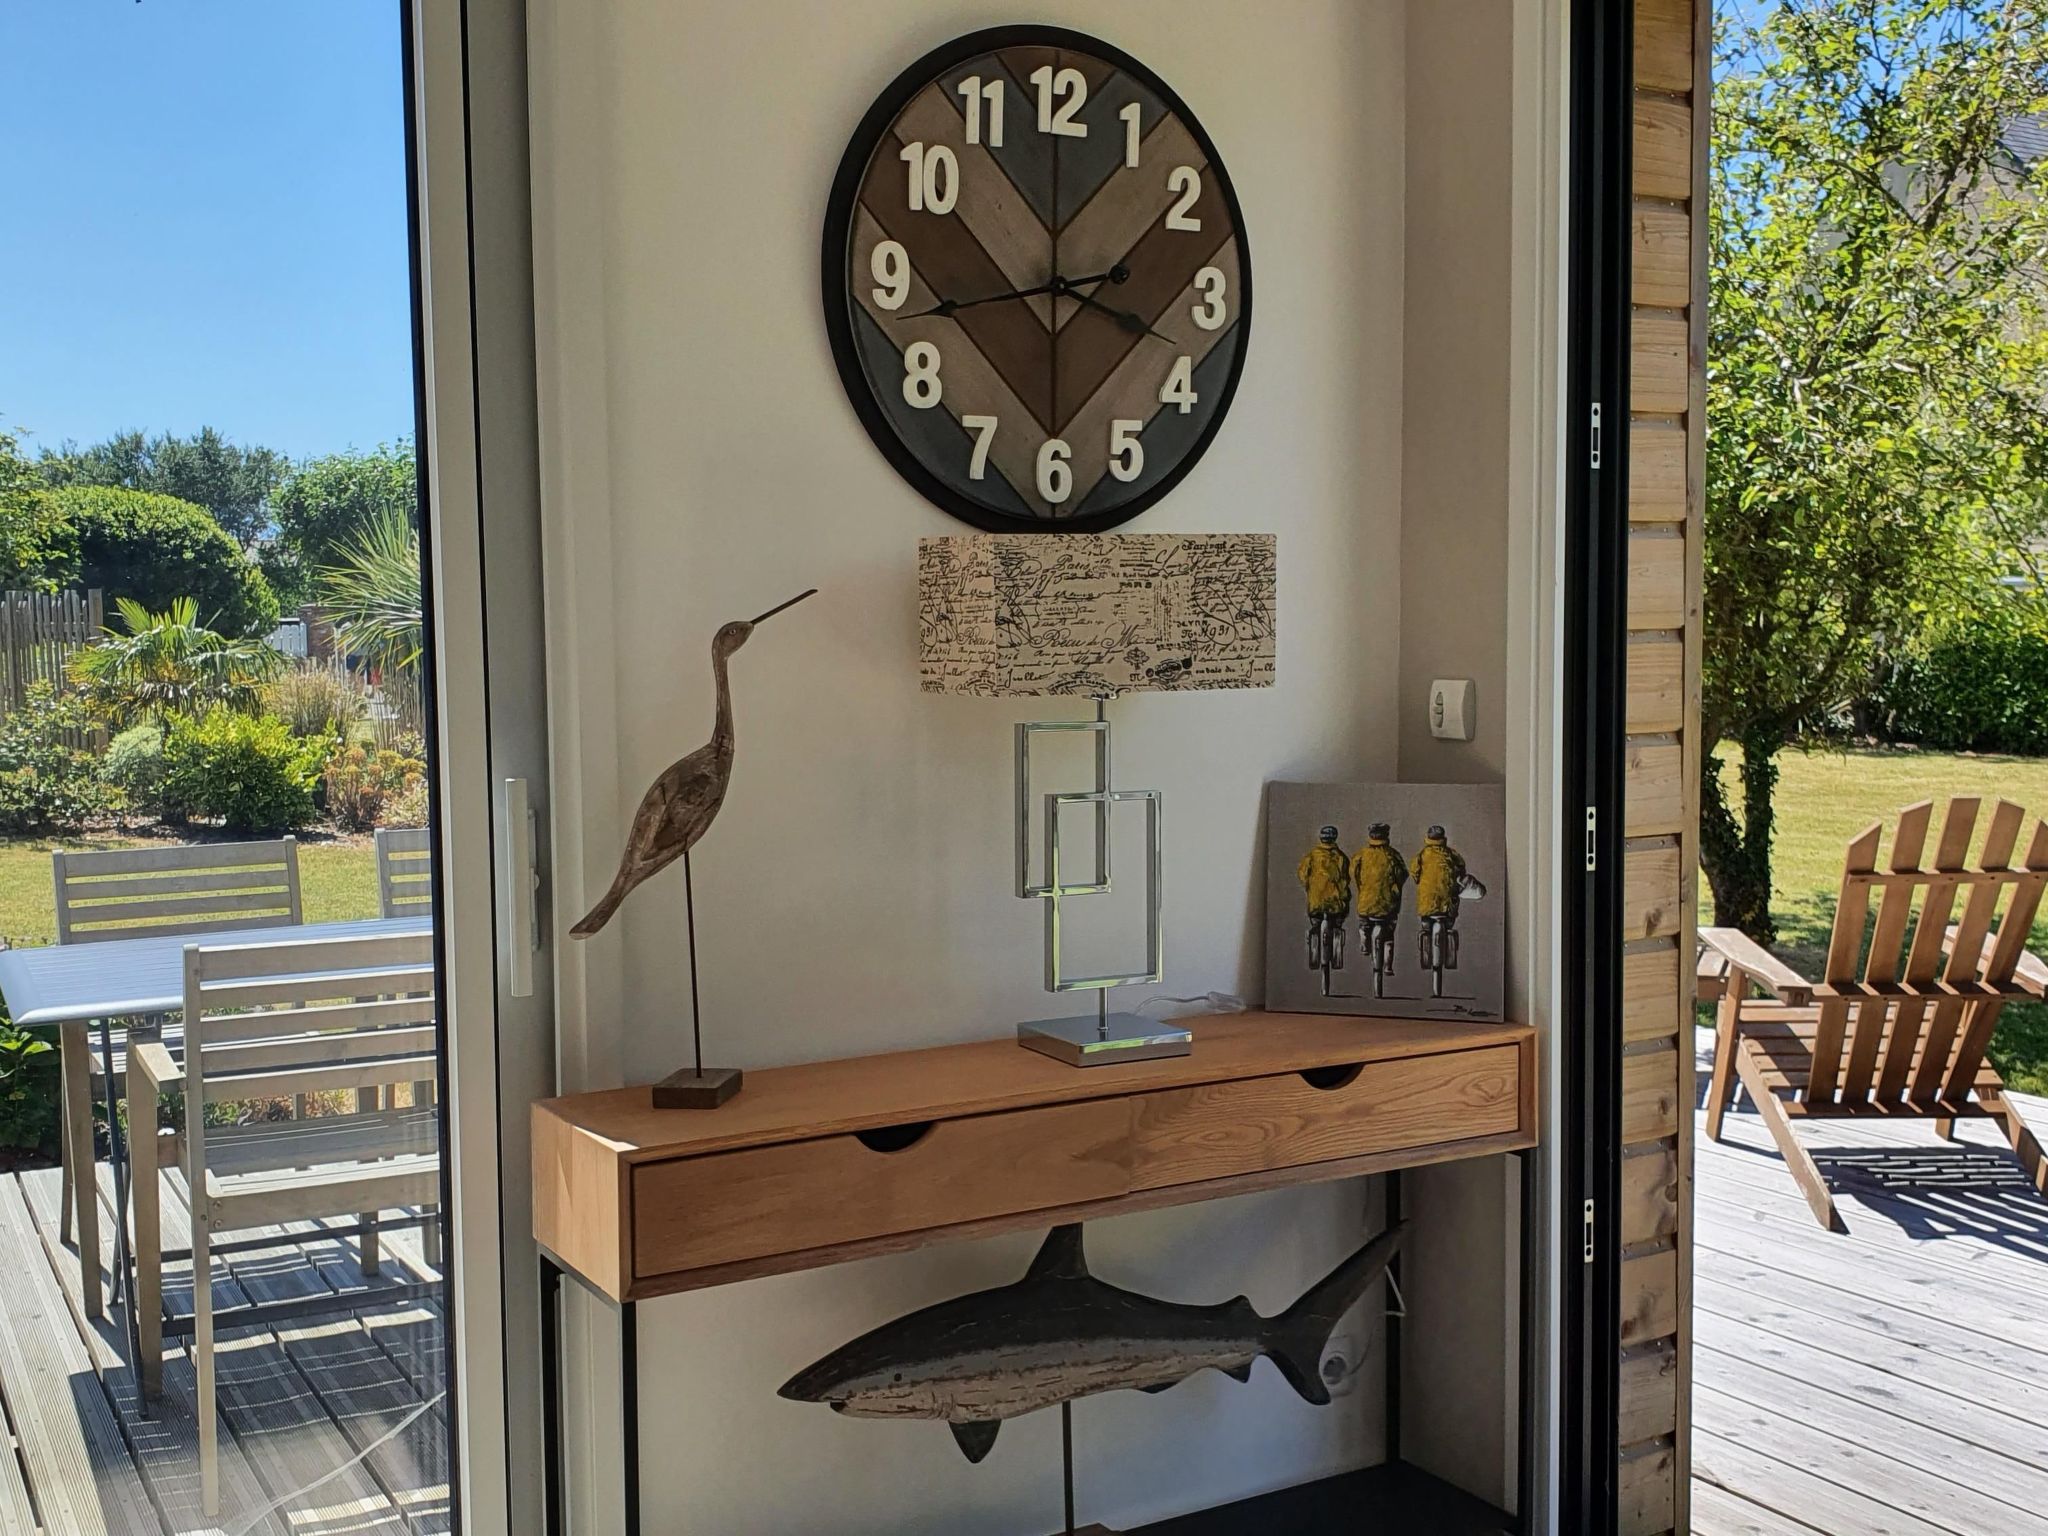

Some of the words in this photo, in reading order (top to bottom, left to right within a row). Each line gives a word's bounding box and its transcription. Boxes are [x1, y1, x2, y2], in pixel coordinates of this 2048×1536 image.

[957, 75, 1005, 147] 11
[1030, 65, 1088, 138] 12
[1119, 102, 1141, 168] 1
[900, 141, 960, 215] 10
[1165, 165, 1202, 231] 2
[870, 240, 911, 311] 9
[1191, 266, 1227, 331] 3
[902, 341, 943, 409] 8
[1158, 355, 1198, 414] 4
[962, 415, 999, 480] 7
[1036, 438, 1073, 503] 6
[1108, 419, 1144, 482] 5
